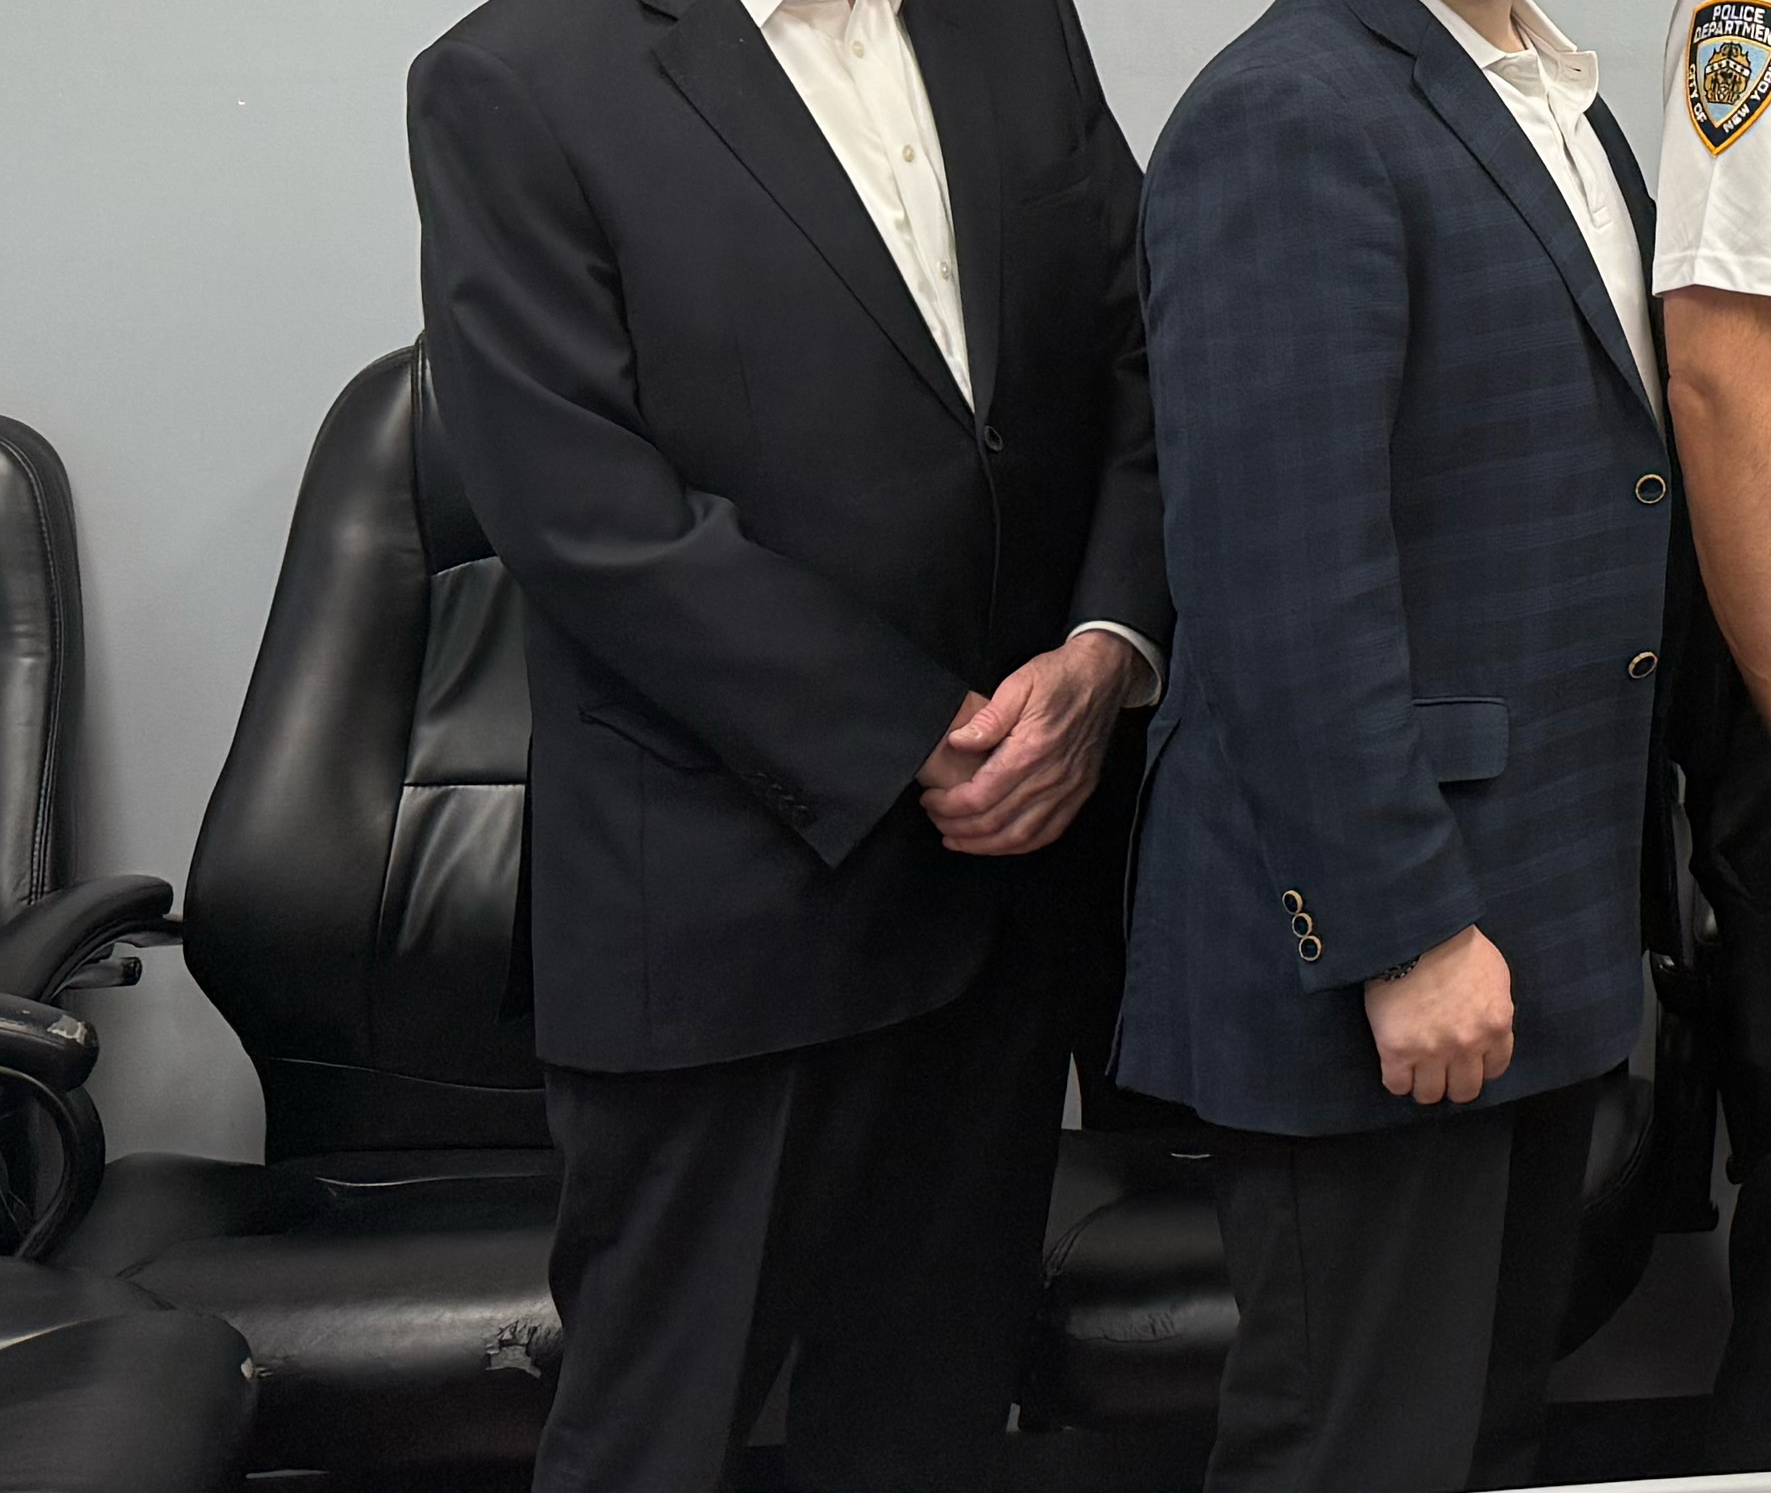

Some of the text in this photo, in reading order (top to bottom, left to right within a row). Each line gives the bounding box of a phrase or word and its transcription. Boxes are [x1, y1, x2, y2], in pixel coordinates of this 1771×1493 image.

[1712, 4, 1765, 24] POLICE
[1689, 64, 1698, 99] CITY
[1693, 104, 1707, 123] OF
[1723, 104, 1750, 133] NEW
